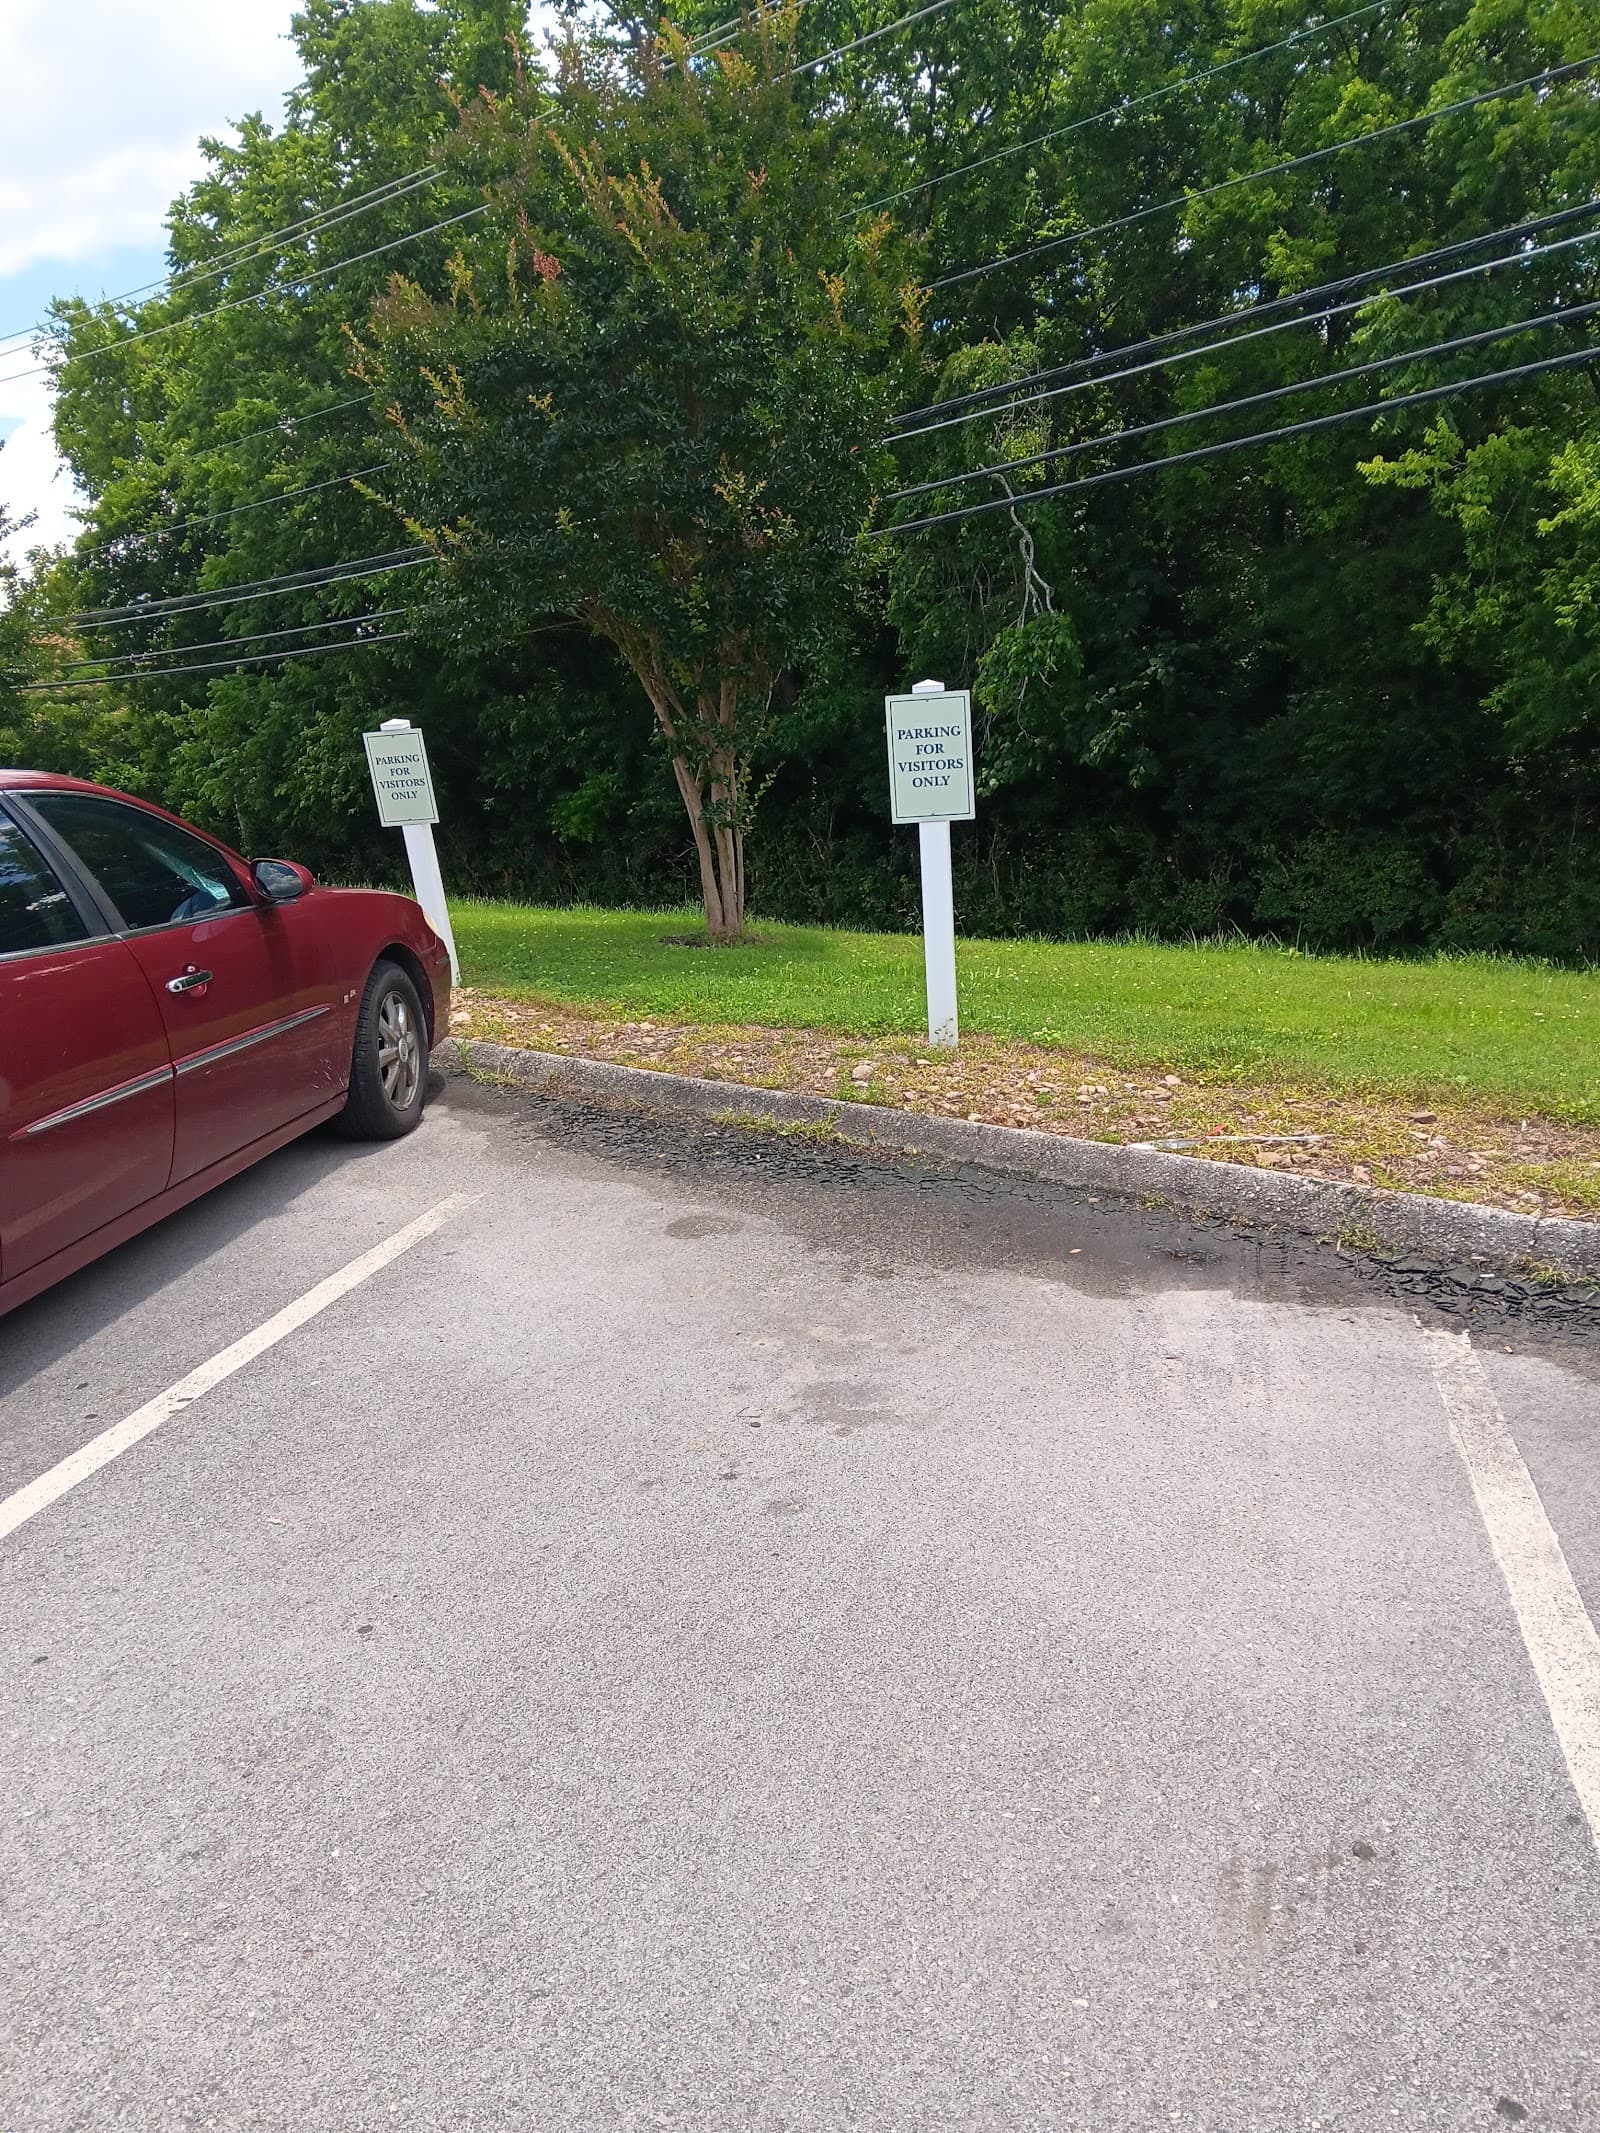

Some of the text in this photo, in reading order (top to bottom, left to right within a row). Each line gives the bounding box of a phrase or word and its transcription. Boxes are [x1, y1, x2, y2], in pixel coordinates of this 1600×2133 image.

[897, 725, 961, 740] PARKING
[916, 743, 944, 755] FOR
[375, 754, 420, 765] PARKING
[898, 758, 964, 773] VISITORS
[390, 767, 410, 776] FOR
[379, 778, 426, 789] VISITORS
[912, 775, 951, 788] ONLY
[391, 790, 418, 800] ONLY
